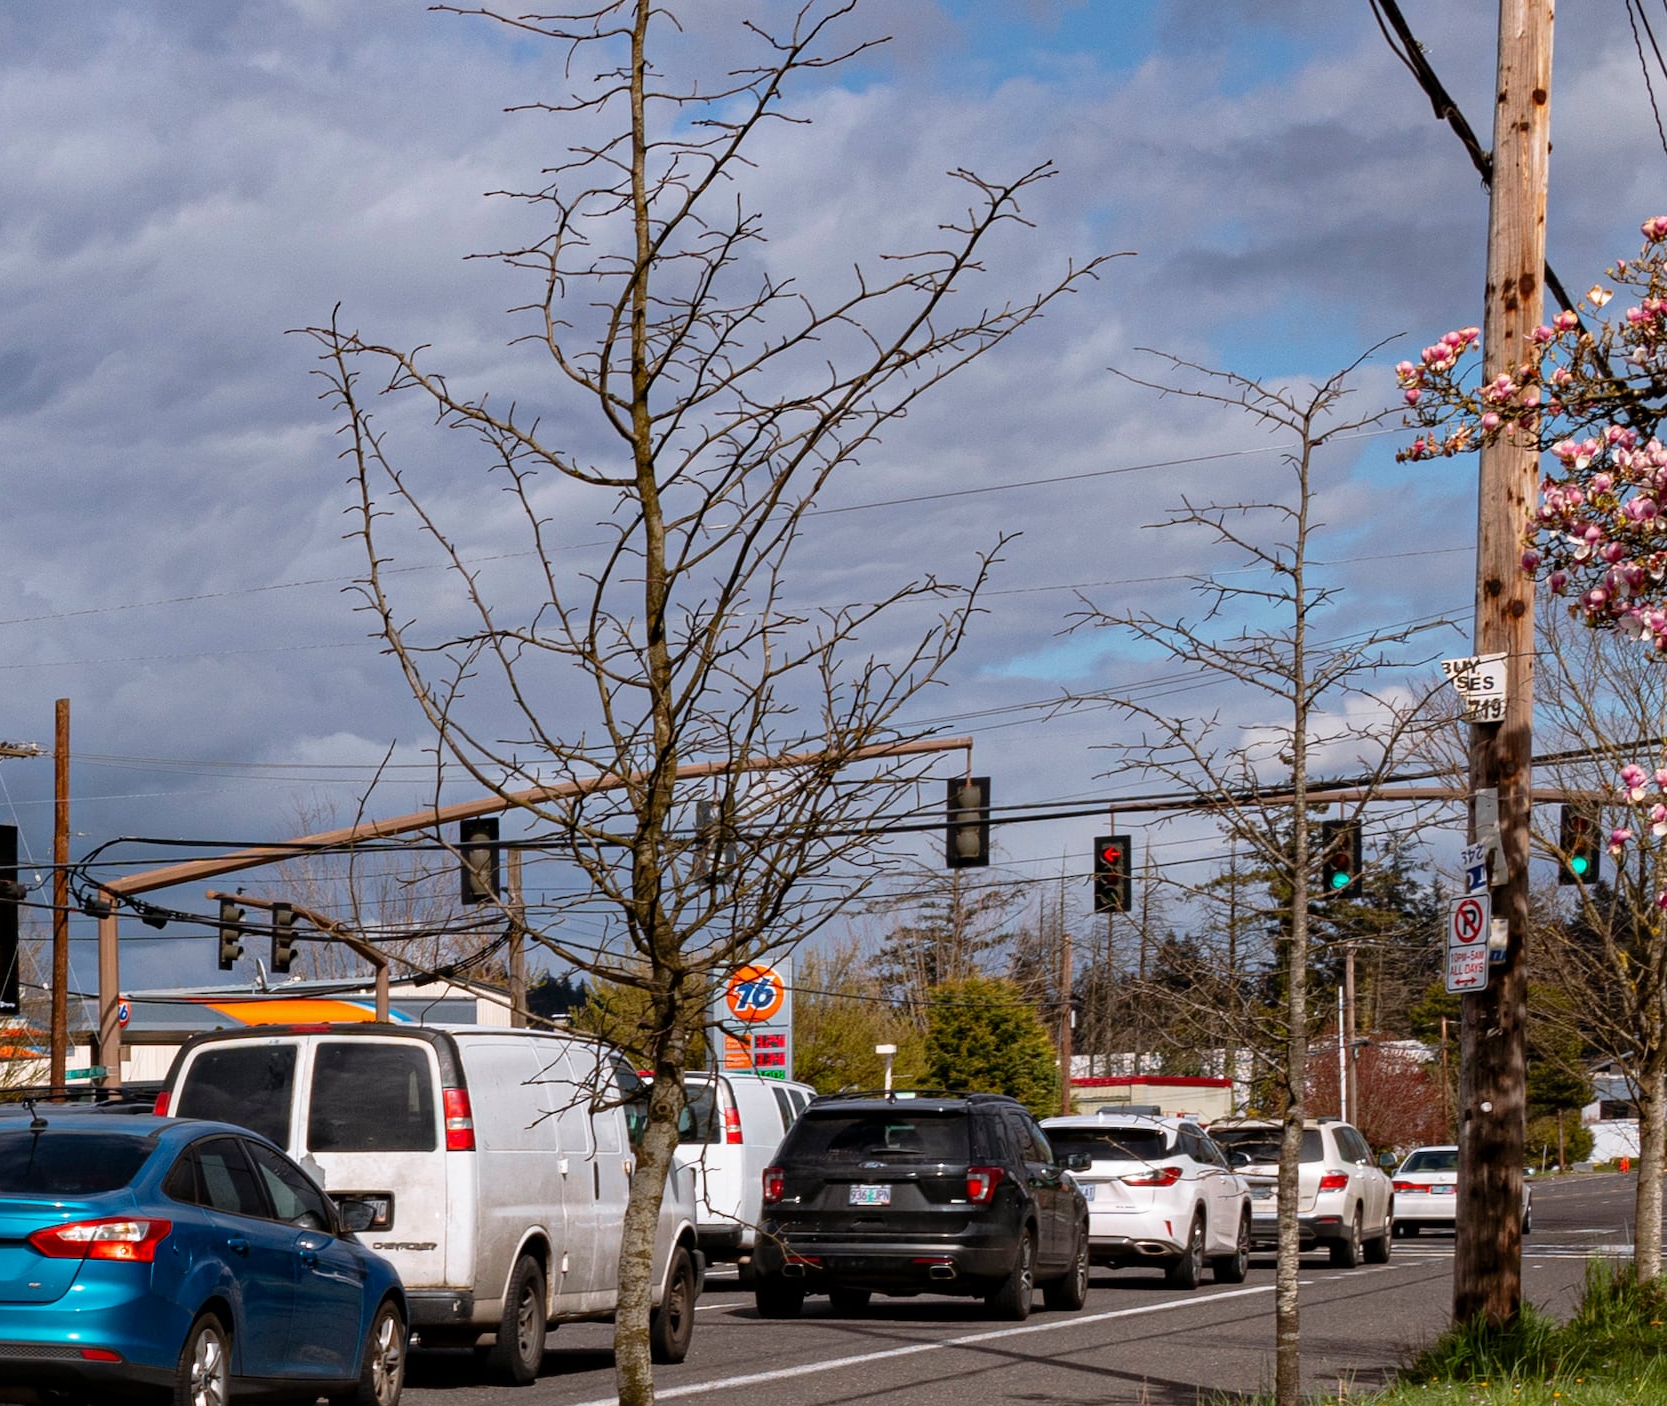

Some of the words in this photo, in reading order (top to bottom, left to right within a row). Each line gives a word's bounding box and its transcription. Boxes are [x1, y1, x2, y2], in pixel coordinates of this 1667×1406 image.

[1450, 964, 1464, 976] ALL
[1464, 962, 1484, 975] DAYS
[732, 976, 777, 1011] 76
